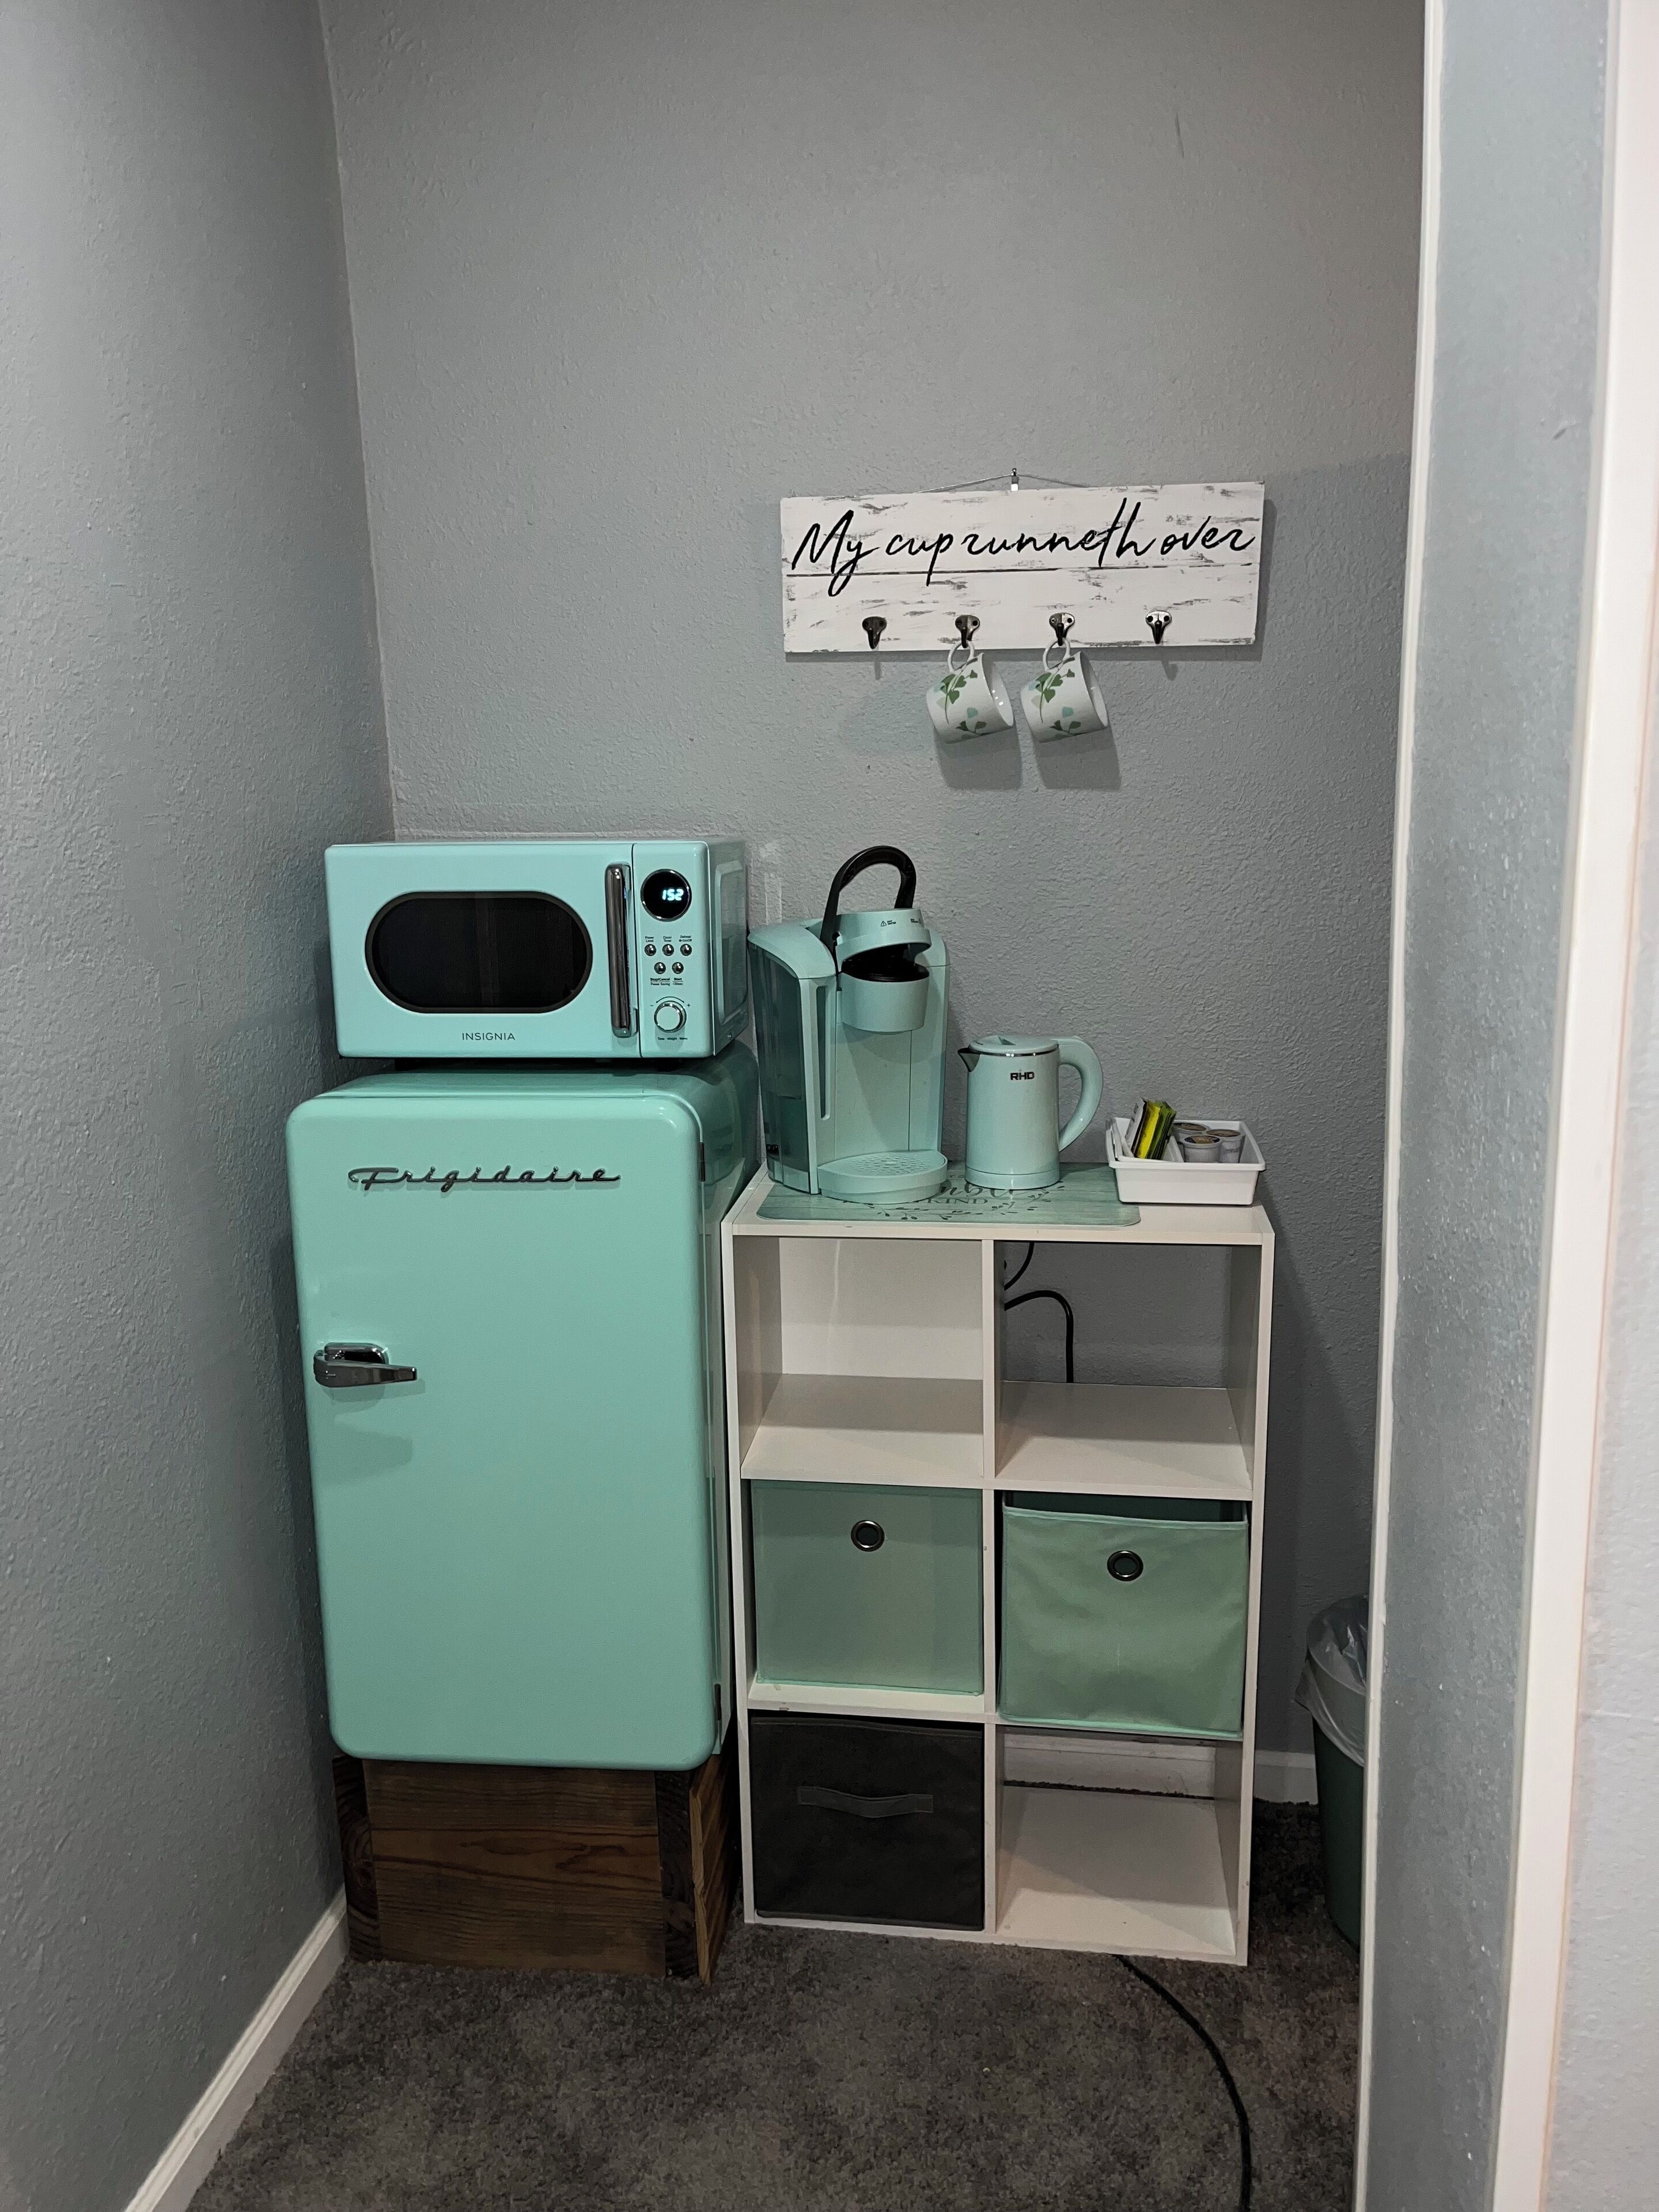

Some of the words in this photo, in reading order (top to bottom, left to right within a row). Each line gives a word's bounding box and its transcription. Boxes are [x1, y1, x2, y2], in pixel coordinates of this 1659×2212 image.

[792, 510, 880, 597] My
[885, 527, 956, 586] cup
[959, 497, 1154, 568] runneth
[1159, 516, 1256, 554] over
[462, 1032, 516, 1040] INSIGNIA
[1010, 1071, 1035, 1080] RHD
[348, 1165, 621, 1192] Frigidaire
